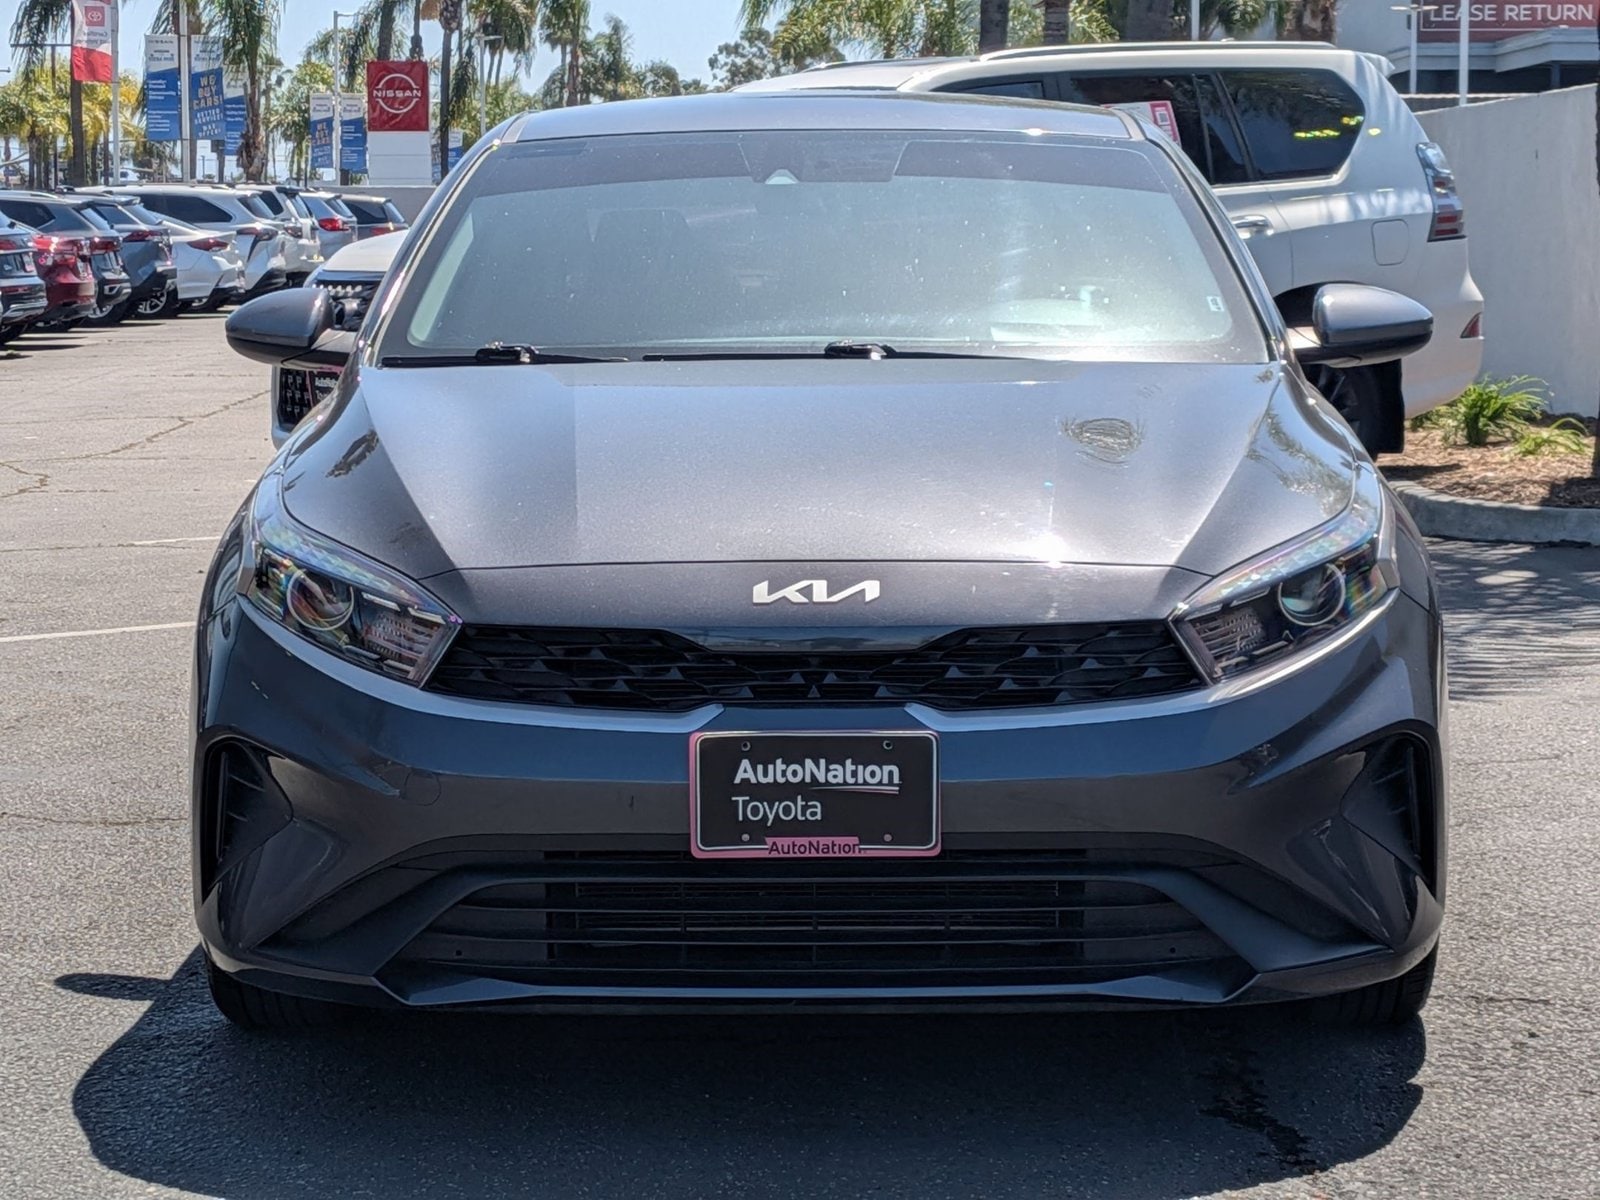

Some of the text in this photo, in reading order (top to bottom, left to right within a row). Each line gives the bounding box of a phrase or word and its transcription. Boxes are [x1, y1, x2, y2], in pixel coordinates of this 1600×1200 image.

[1504, 4, 1593, 21] RETURN
[373, 89, 422, 97] NISSAN
[733, 758, 900, 784] AutoNation
[731, 795, 822, 826] Toyota
[768, 840, 860, 855] AutoNation
